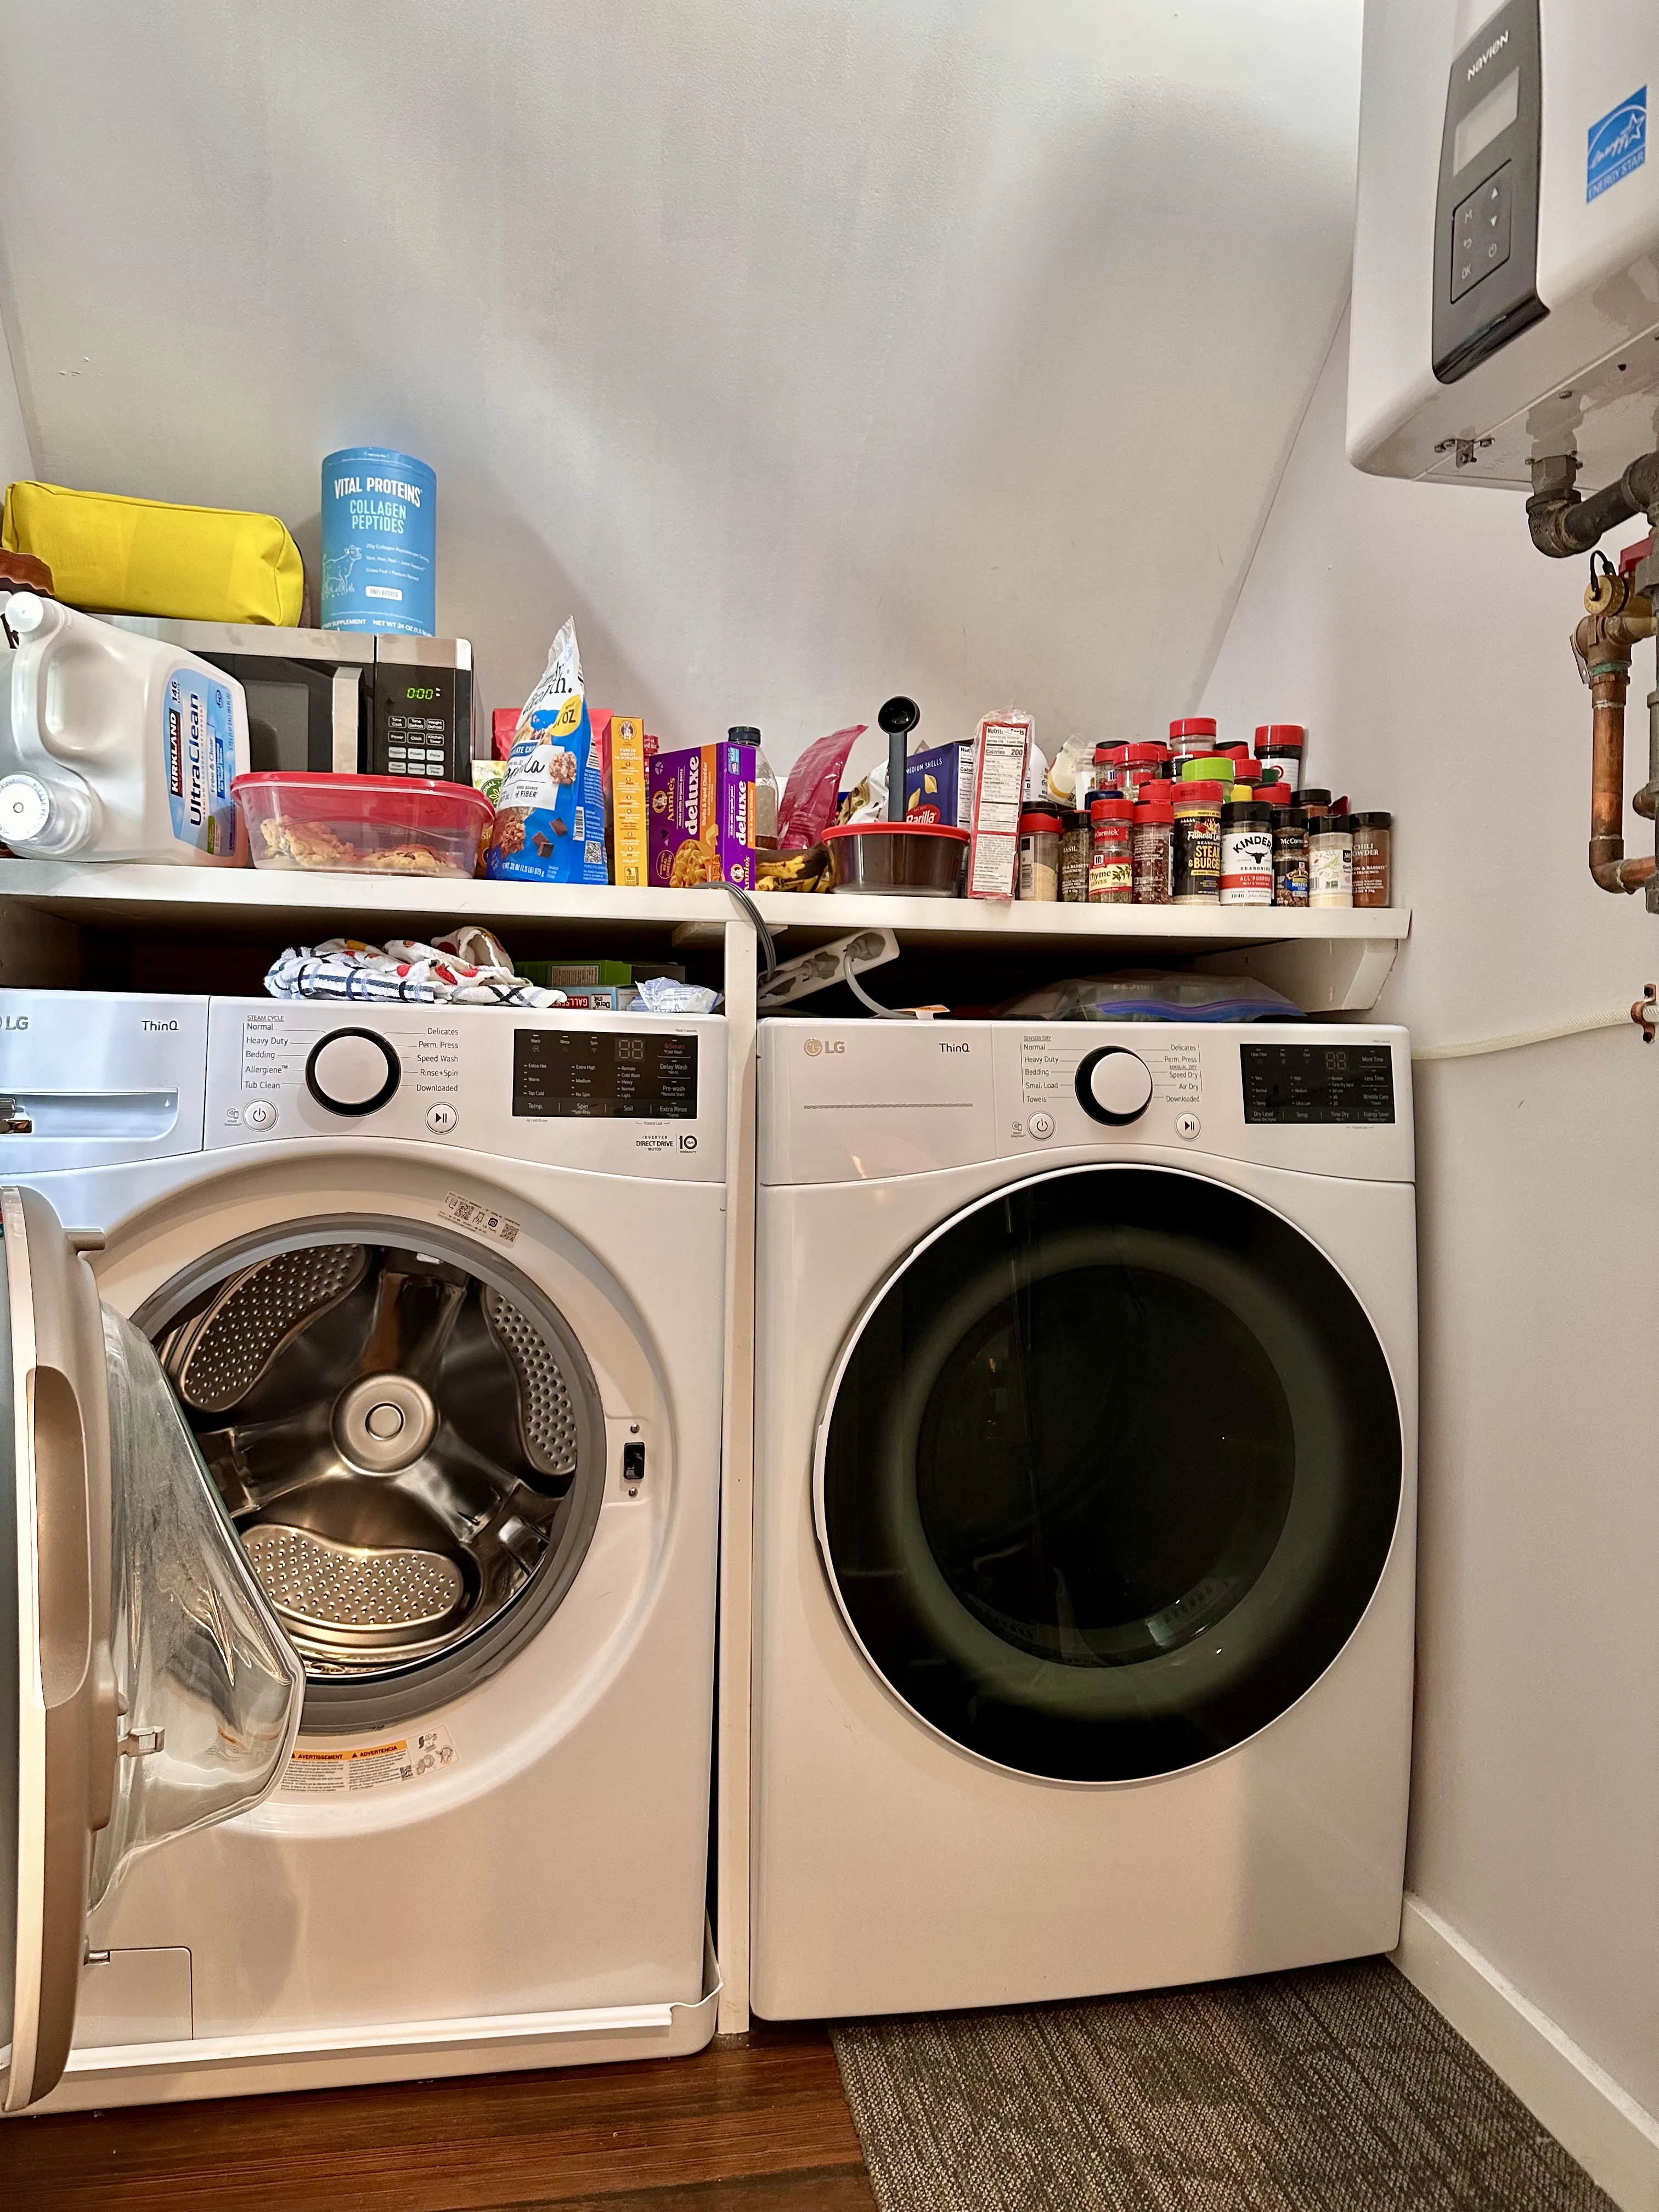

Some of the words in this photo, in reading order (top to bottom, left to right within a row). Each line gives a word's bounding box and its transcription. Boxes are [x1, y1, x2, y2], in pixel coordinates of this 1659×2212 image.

[1620, 148, 1645, 181] STAR
[1462, 263, 1471, 279] OK
[334, 476, 363, 500] VITAL
[366, 477, 421, 508] PROTEINS
[349, 500, 407, 519] COLLAGEN
[352, 515, 404, 534] PEPTIDES
[370, 589, 399, 597] UNFLAVORED
[332, 619, 366, 627] SUPPLEMENT
[407, 687, 433, 699] 0:00
[170, 712, 179, 794] KIRKLAND
[189, 693, 201, 826] UltraClean
[906, 764, 924, 774] MEDIUM
[925, 758, 943, 769] SHELLS
[667, 777, 675, 821] Annie's
[685, 756, 699, 835] deluxe
[736, 781, 747, 846] deluxe
[906, 810, 935, 823] Barilla
[1094, 829, 1119, 838] Cormick
[1187, 830, 1213, 841] Famous
[1188, 859, 1193, 867] &
[1194, 857, 1220, 869] BURGE
[1289, 870, 1300, 878] Grill
[5, 1016, 29, 1030] LG
[142, 1020, 179, 1031] ThinQ
[247, 1023, 273, 1031] Normal
[427, 1028, 459, 1036] Delicates
[246, 1036, 268, 1046] Heavy
[270, 1037, 289, 1046] Duty
[419, 1041, 438, 1049] Perm.
[825, 1041, 845, 1054] LG
[939, 1042, 970, 1053] ThinQ
[246, 1050, 275, 1060] Bedding
[417, 1054, 439, 1063] Speed
[420, 1069, 459, 1077] Rinse+Spin
[259, 1081, 280, 1090] Clean
[679, 1135, 698, 1150] 10
[359, 1745, 398, 1757] ADVERTENCIA
